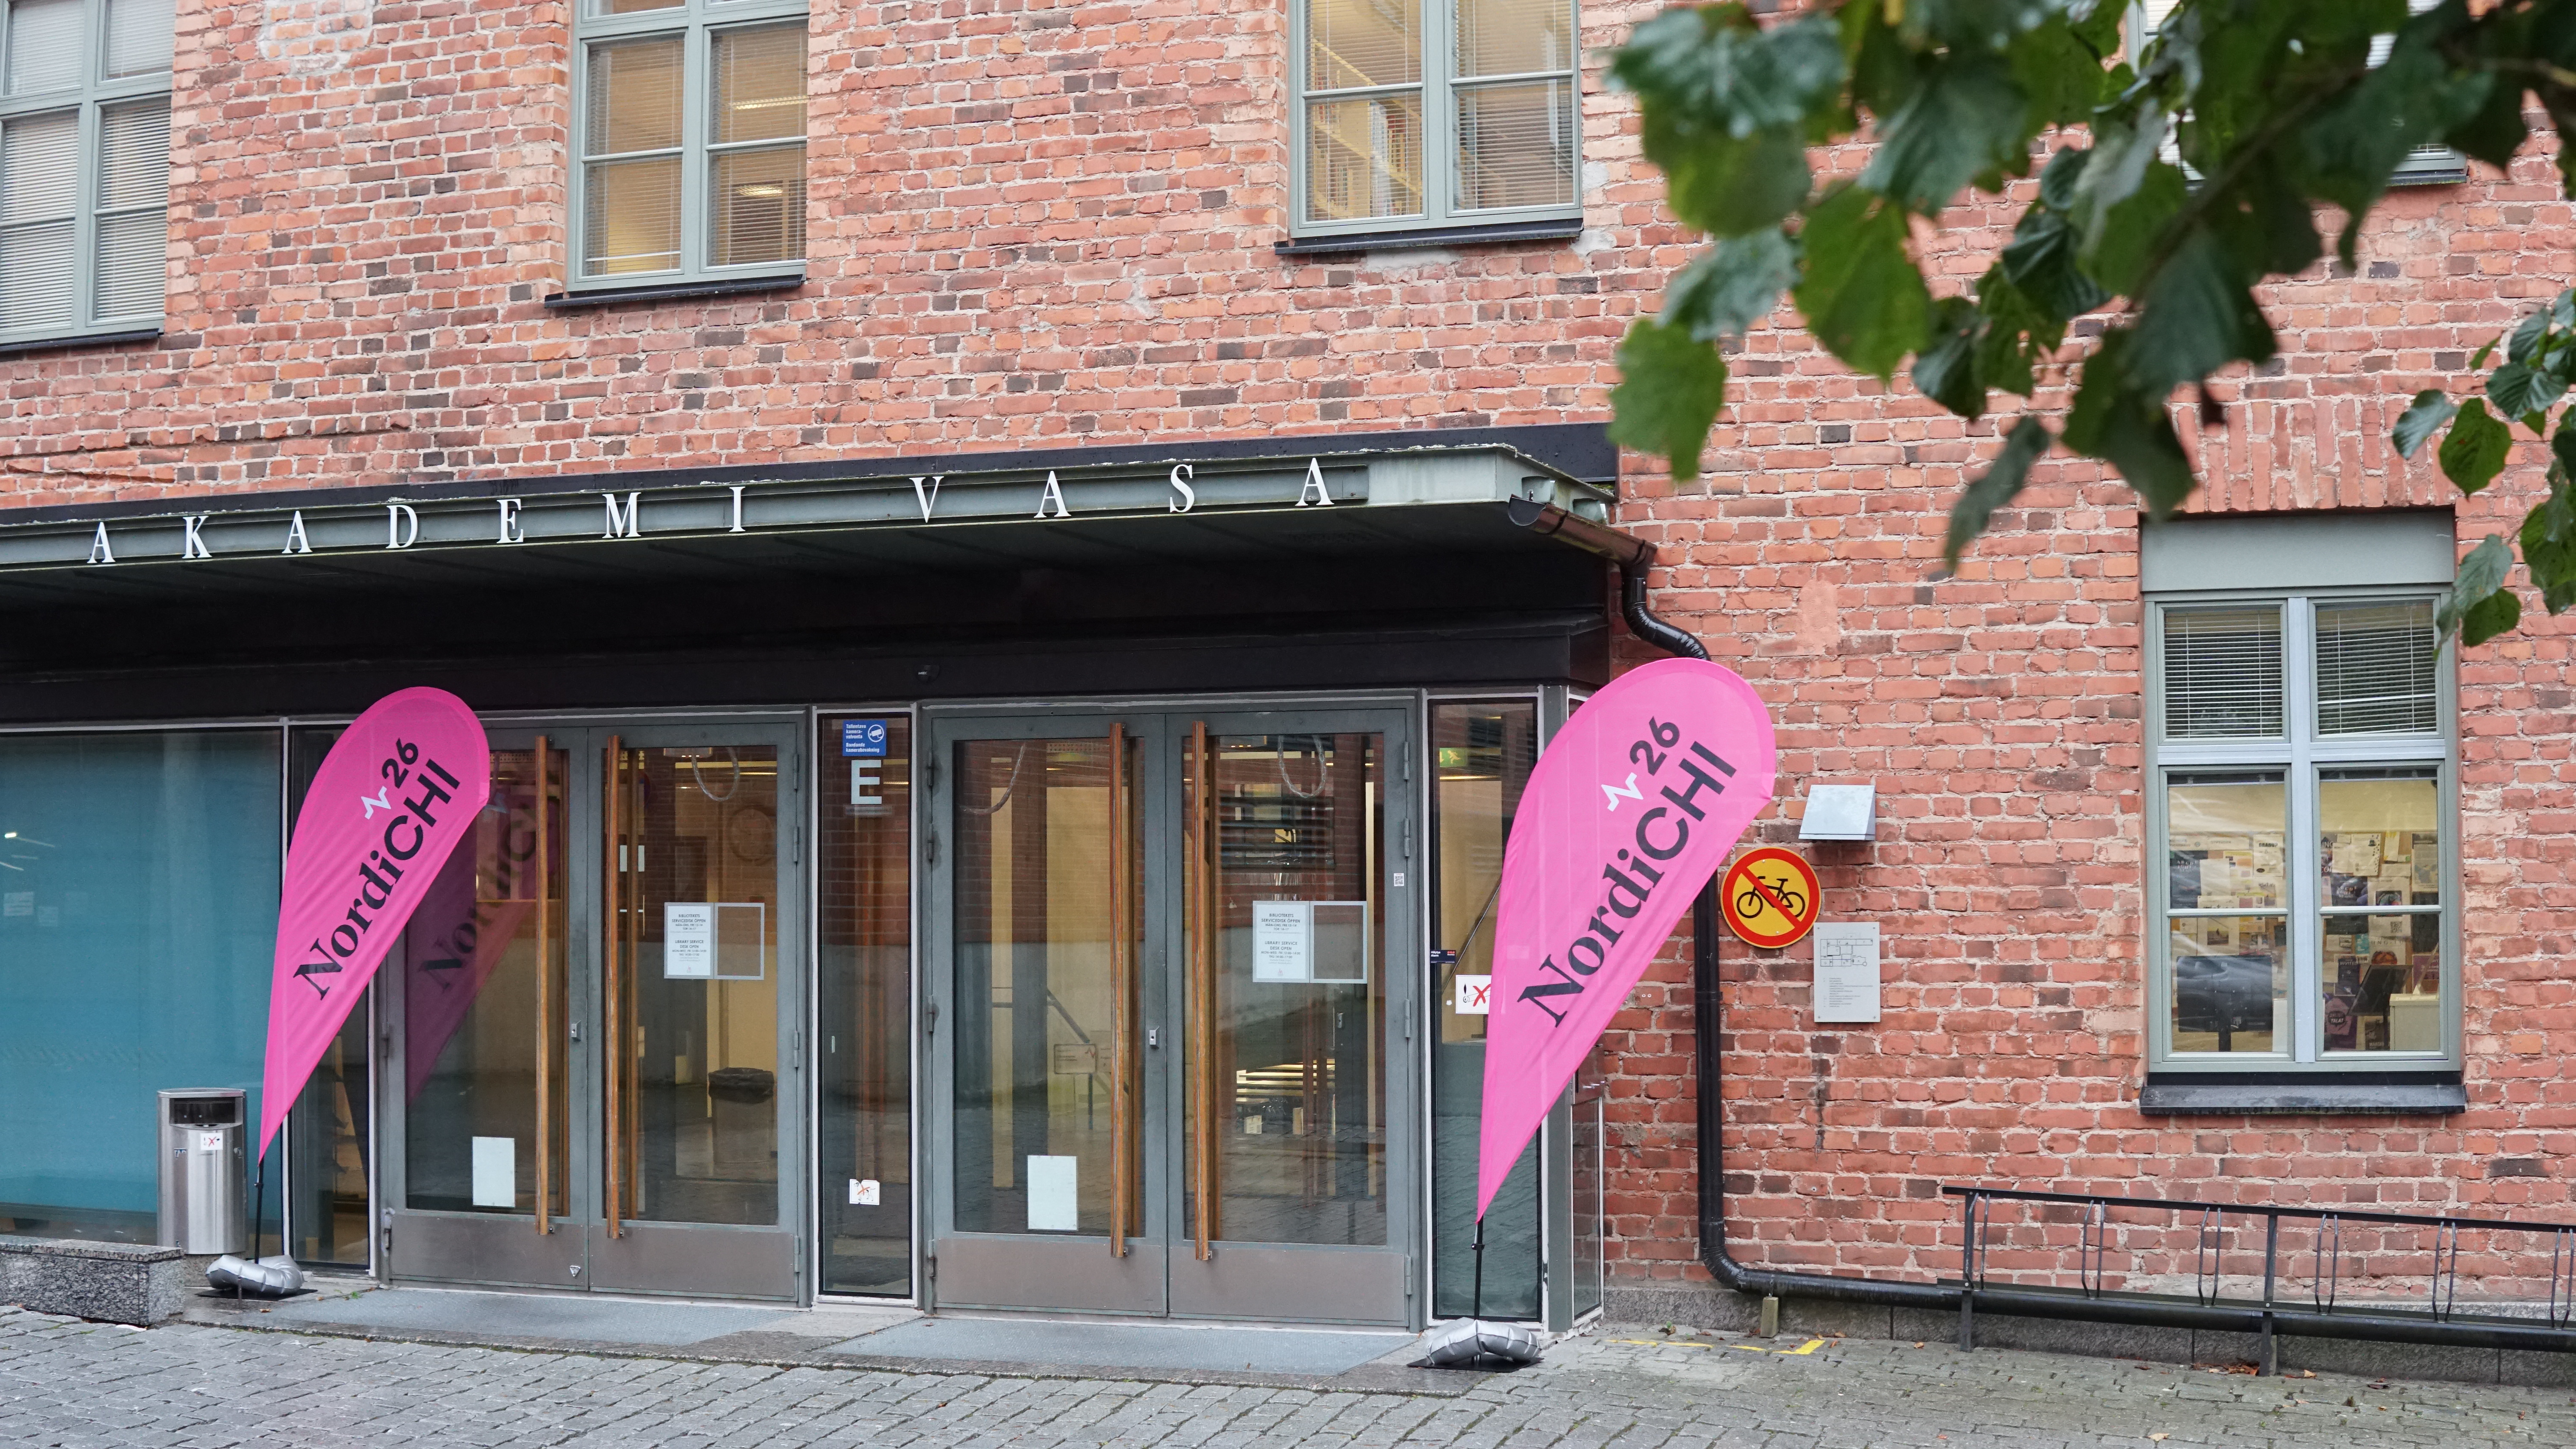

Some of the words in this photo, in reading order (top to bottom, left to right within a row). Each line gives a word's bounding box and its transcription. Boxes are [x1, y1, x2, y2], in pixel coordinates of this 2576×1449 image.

[87, 485, 746, 564] AKADEMI
[909, 457, 1334, 524] VASA
[382, 738, 419, 789] 26
[851, 760, 882, 804] E
[1629, 716, 1680, 776] 26
[293, 759, 460, 1000] NordiCHI
[1517, 741, 1738, 1028] NordiCHI
